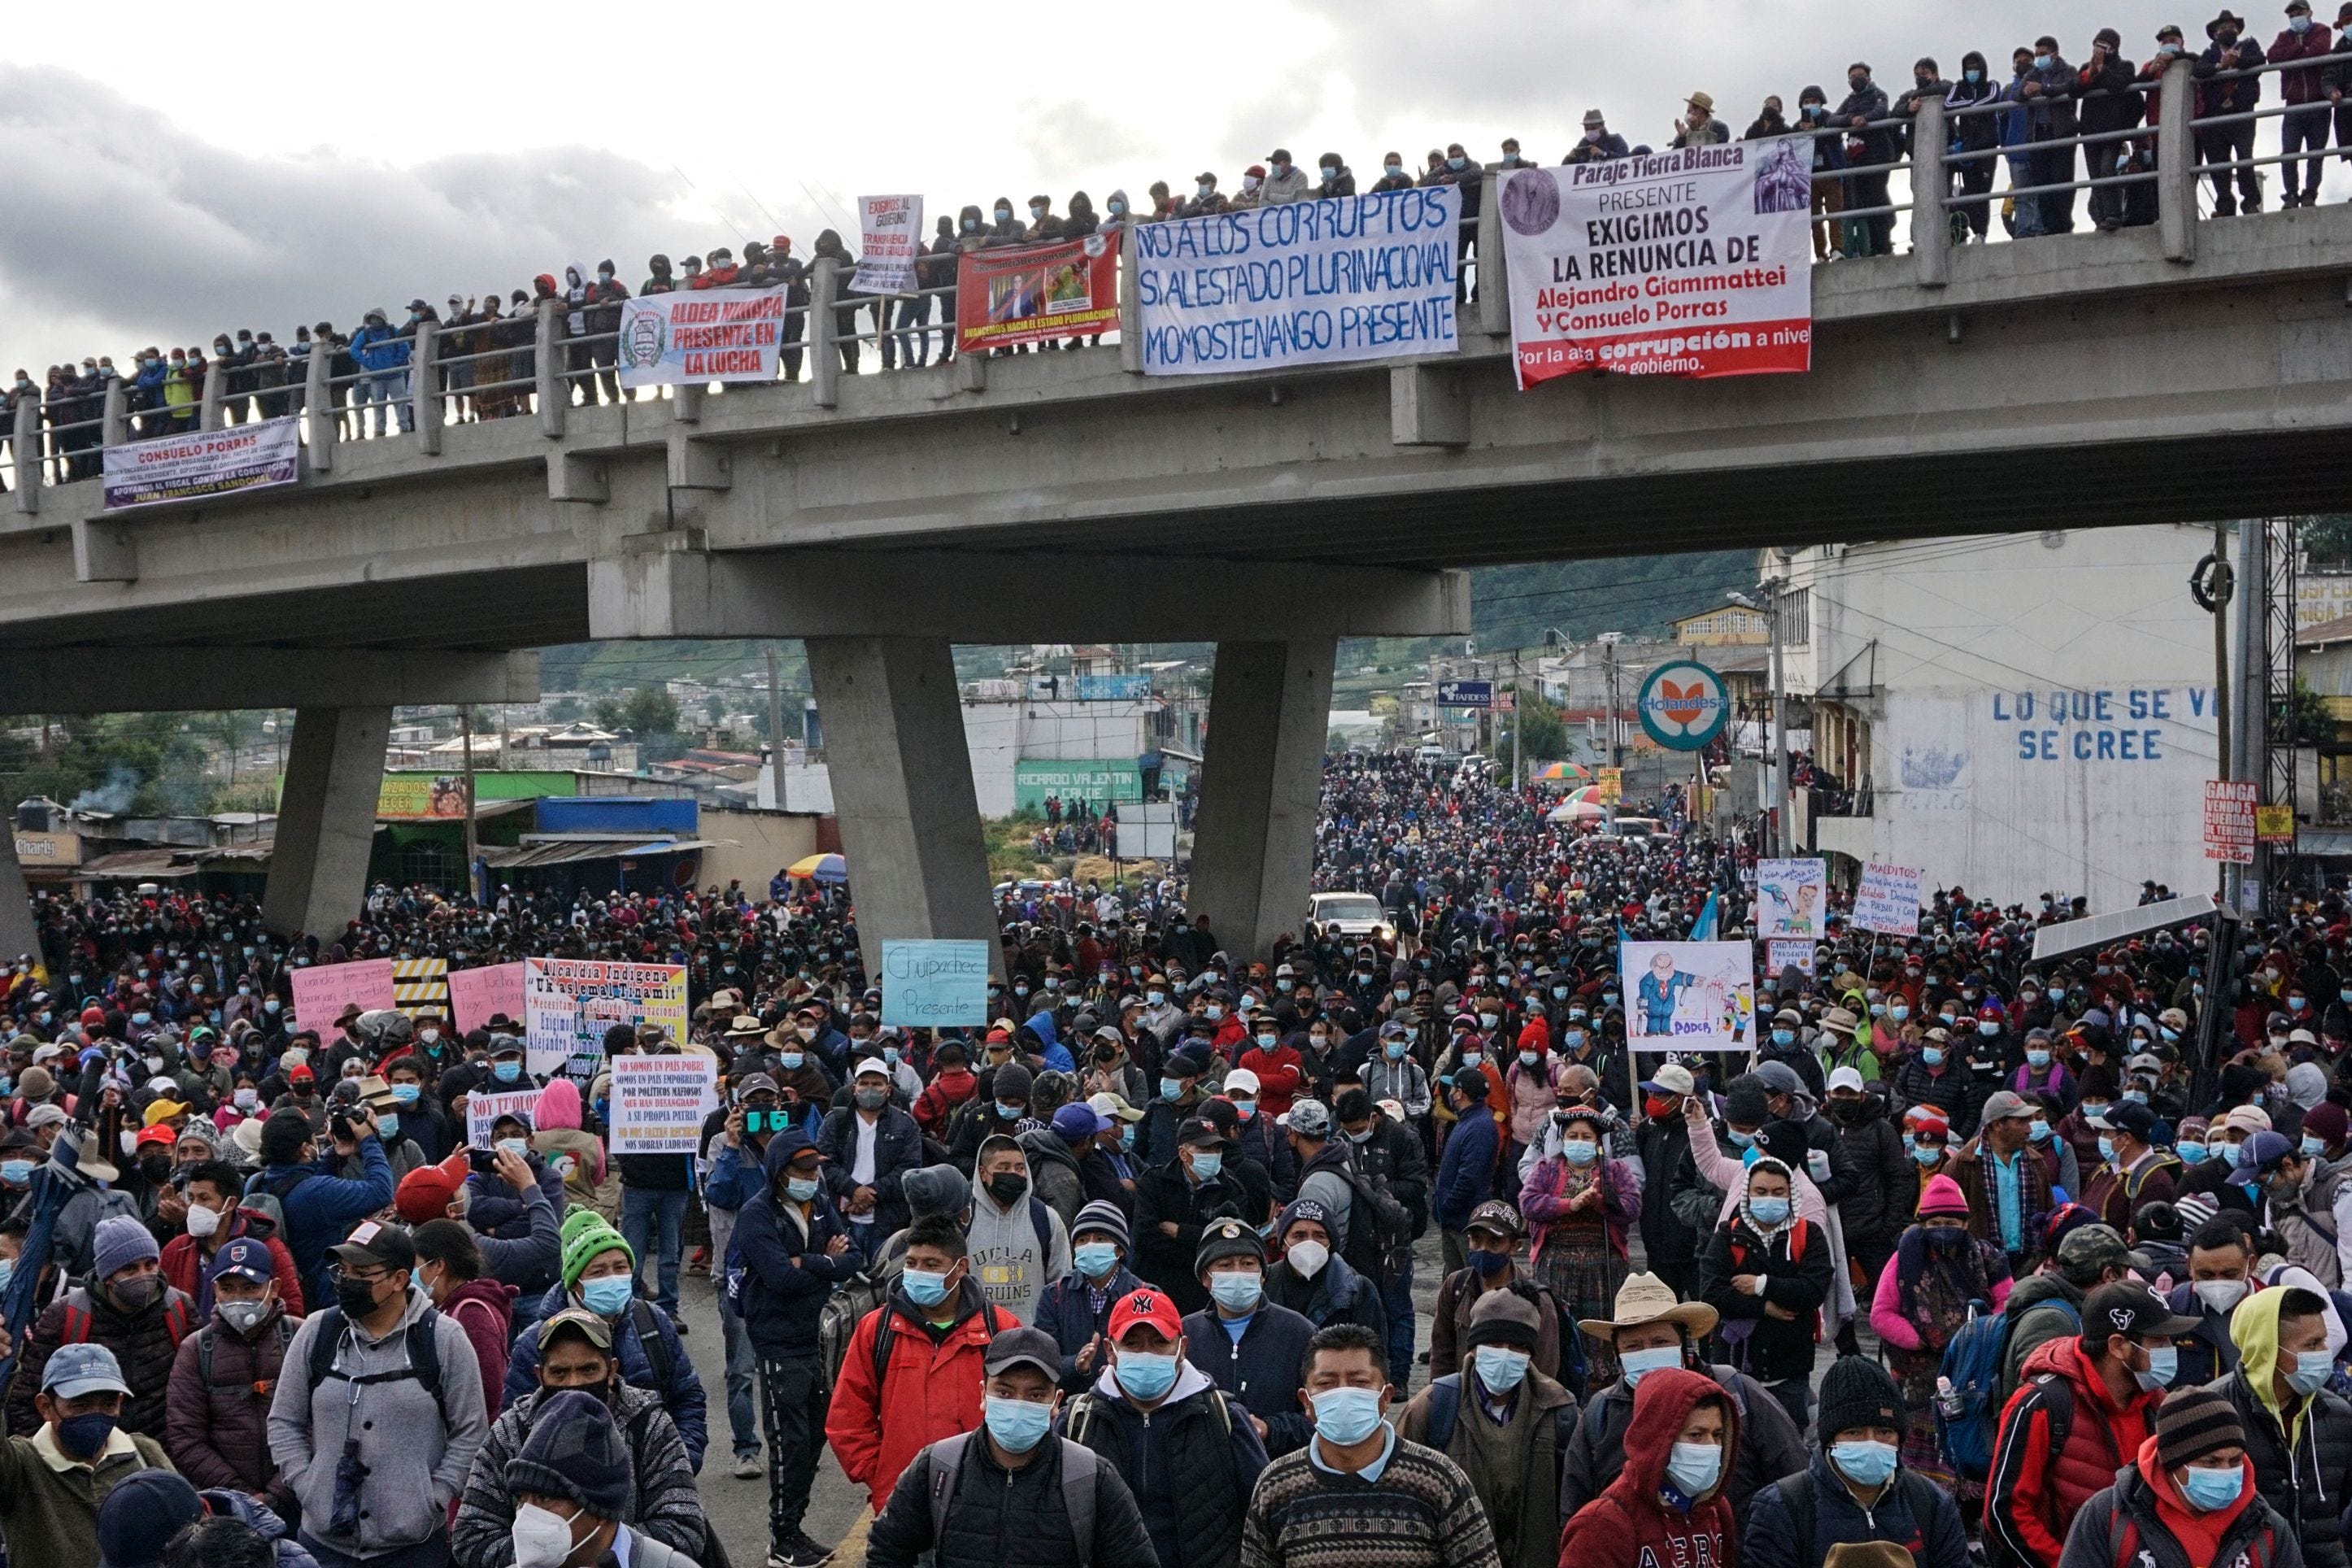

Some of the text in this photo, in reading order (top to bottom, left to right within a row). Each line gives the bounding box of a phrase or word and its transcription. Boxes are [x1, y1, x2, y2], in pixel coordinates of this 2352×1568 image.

[1573, 146, 1744, 188] Paraje Tierra Blanca
[901, 198, 910, 210] AL
[1599, 181, 1696, 212] PRESENTE
[1136, 186, 1448, 258] NO A LOS CORRUPTOS
[1587, 205, 1709, 247] EXIGIMOS
[1289, 242, 1457, 295] PLURINACIONAL
[1553, 235, 1760, 283] LA RENUNCIA DE
[1536, 265, 1786, 310] Alejandro Giammattei
[670, 302, 719, 324] ALDEA
[1536, 298, 1727, 333] Y Consuelo Porras
[673, 323, 775, 351] PRESENTE EN
[965, 326, 1006, 338] AVANCEMOS
[1007, 322, 1028, 332] HACIA
[1030, 320, 1036, 329] EL
[1038, 317, 1063, 328] ESTADO
[1145, 295, 1453, 365] MOMOSTENANGO PRESENTE
[1548, 347, 1562, 363] la
[1599, 329, 1751, 360] corrupción
[1757, 333, 1767, 346] a
[685, 350, 762, 376] LA LUCHA
[1629, 356, 1705, 374] gobierno.
[138, 435, 257, 464] CONSUELO PORRAS
[114, 485, 154, 495] APOYAMOS
[165, 479, 190, 488] FISCAL
[194, 474, 224, 485] CONTRA
[133, 475, 270, 502] JUAN FRANCISCO SANDOVAL
[1640, 695, 1727, 712] Holandesa
[1993, 690, 2032, 721] LO
[2049, 690, 2113, 725] QUE
[2129, 690, 2171, 720] SE
[2019, 730, 2162, 760] SE CREE
[1018, 772, 1132, 786] RICARDO VALENTIN
[1044, 787, 1103, 799] ALCALDE
[2206, 782, 2257, 802] GANGA
[2206, 800, 2251, 813] VENDO 5
[2206, 813, 2254, 826] CUERDAS
[2206, 825, 2254, 837] DE TERRENO
[15, 838, 55, 857] Charly
[2206, 848, 2252, 862] 3683-4842
[1868, 863, 1917, 878] MALDITOS
[455, 975, 471, 991] La
[542, 962, 669, 985] Alcaldía Indígena
[903, 988, 969, 1016] Presente
[540, 1013, 573, 1038] Exigimos
[529, 1032, 567, 1054] Alejandro
[620, 1059, 704, 1072] NO SOMOS UN PAÍS POBRE
[616, 1073, 708, 1085] SOMOS UN PAÍS EMPOBRECIDO
[622, 1086, 702, 1096] POR POLÍTICOS MAFIOSOS
[473, 1099, 493, 1117] SOY
[625, 1099, 699, 1108] QUE HAN DESANGRADO
[627, 1110, 697, 1122] A SU PROPIA PATRIA
[670, 1126, 699, 1137] RECURSO
[625, 1139, 696, 1149] NOS SOBRAN LADRONES
[973, 1247, 1032, 1265] UCLA
[985, 1284, 1030, 1300] RUINS
